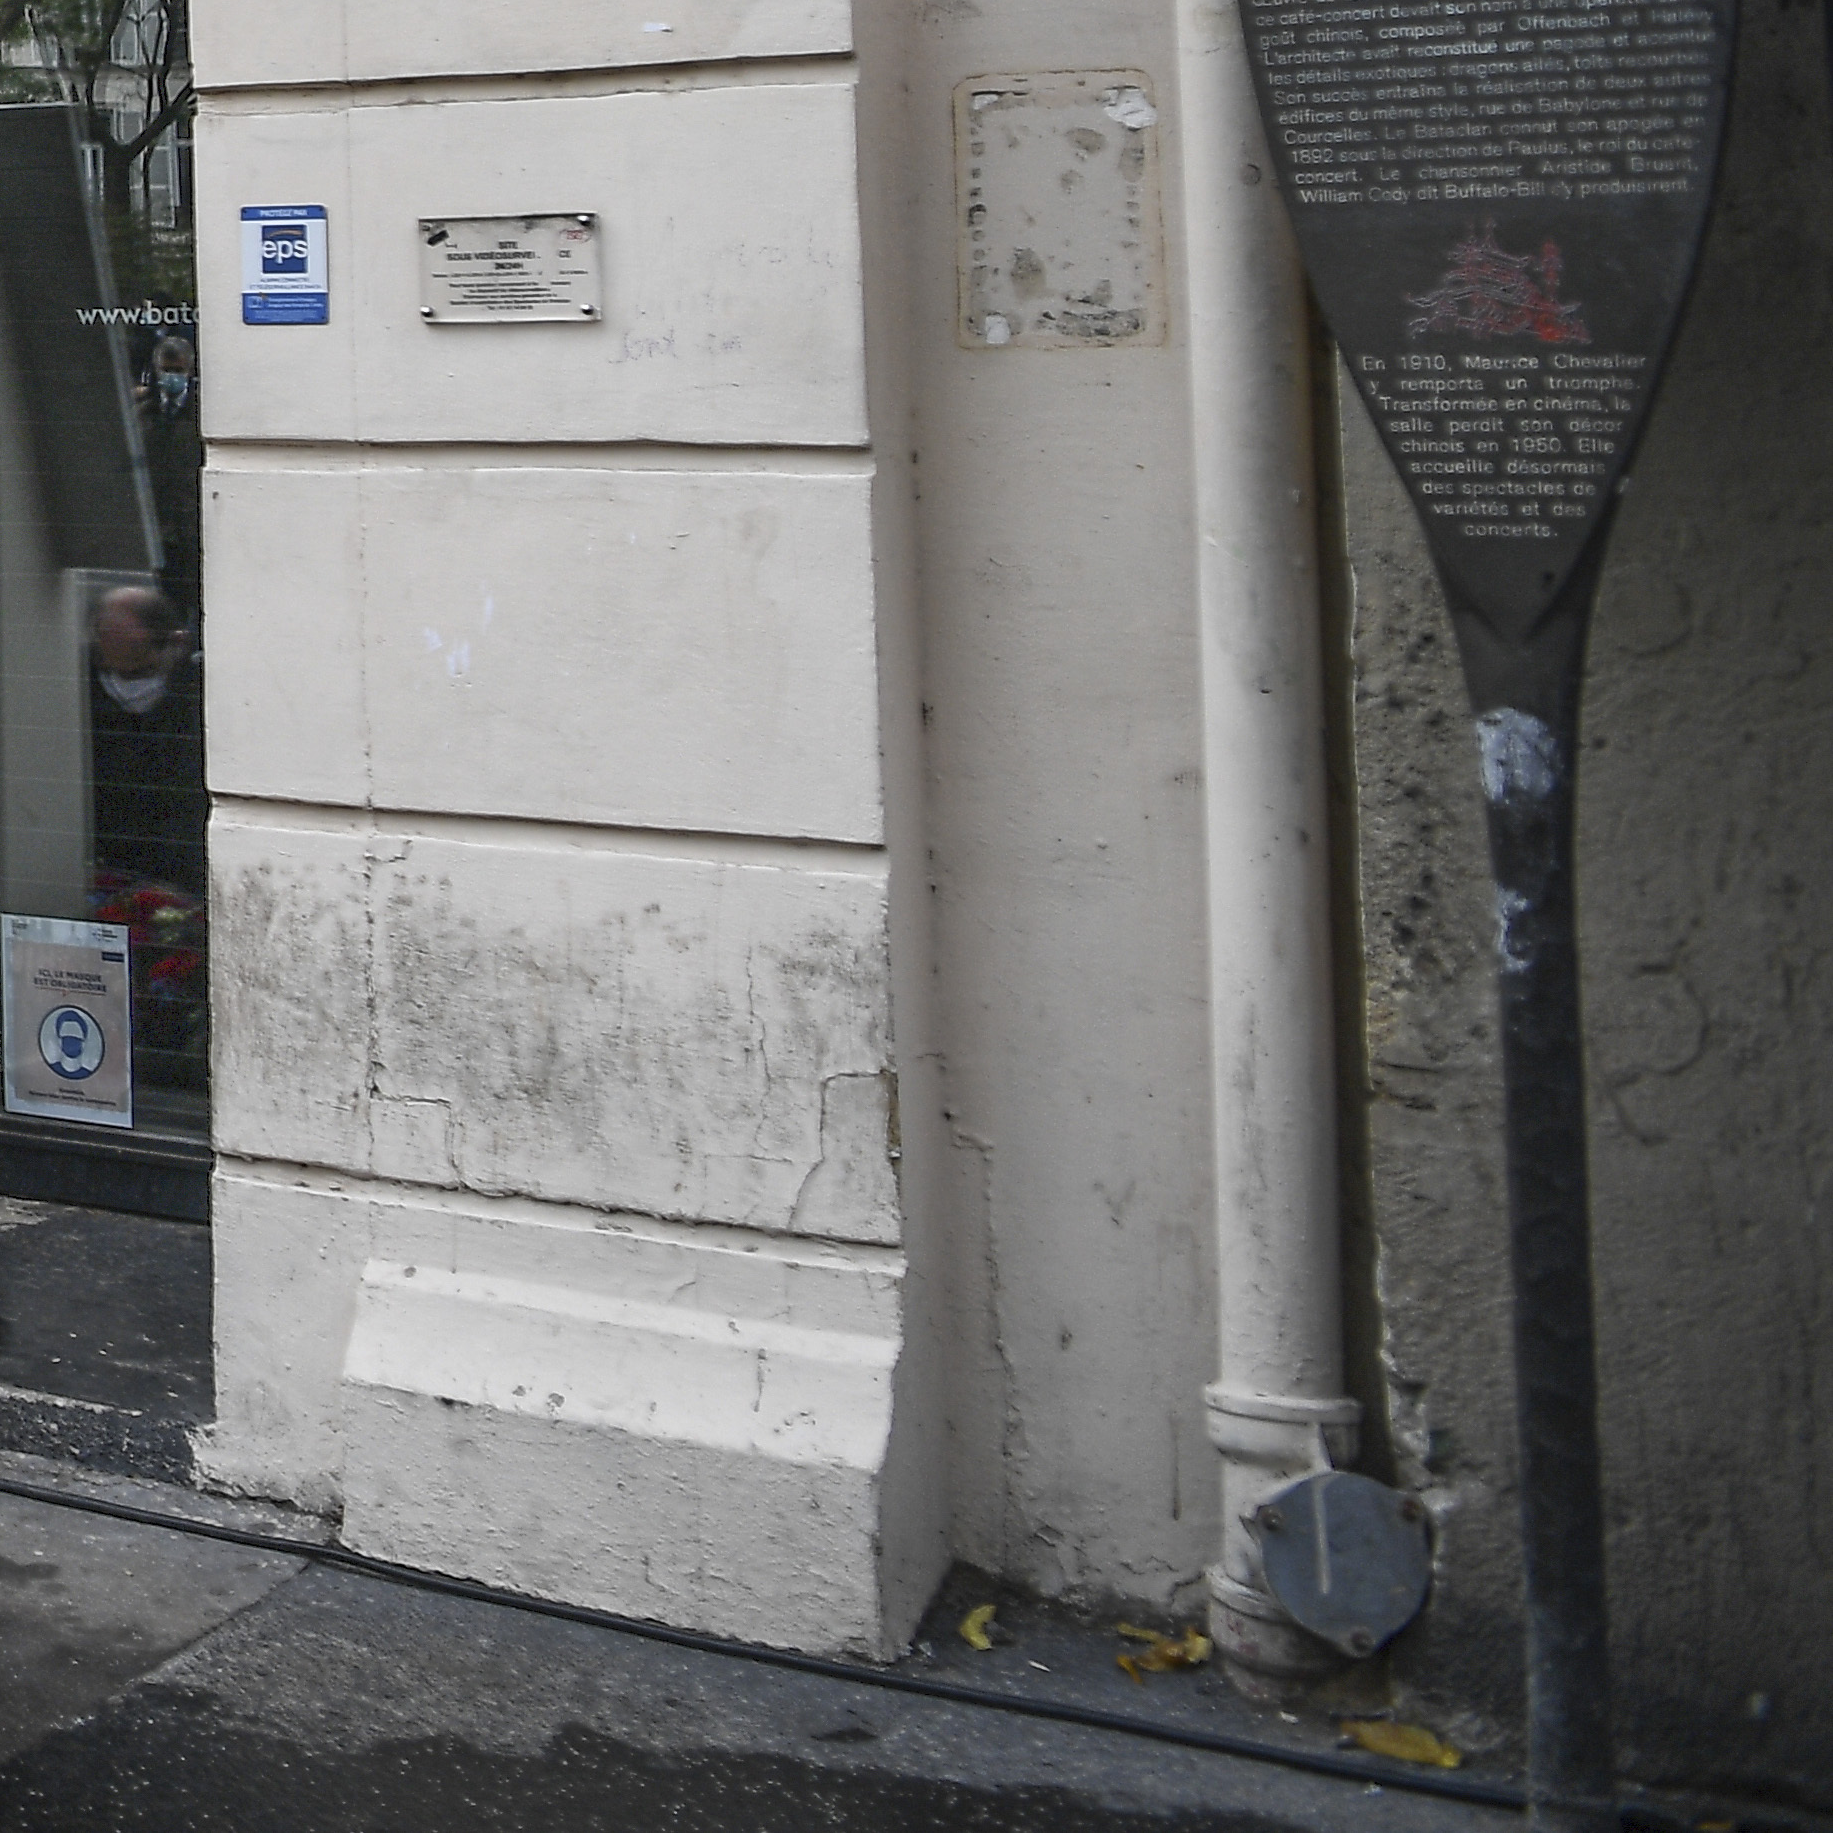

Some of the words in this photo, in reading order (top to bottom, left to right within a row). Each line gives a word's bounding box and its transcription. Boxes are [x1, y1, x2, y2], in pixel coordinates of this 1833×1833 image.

[1277, 4, 1386, 25] café-concert
[1445, 1, 1476, 15] son
[1476, 19, 1505, 36] par
[1517, 11, 1610, 31] Offenbach
[1347, 107, 1369, 121] du
[1290, 148, 1335, 163] 1892
[1299, 187, 1363, 203] William
[1367, 186, 1412, 205] Cody
[1416, 186, 1439, 200] dit
[263, 240, 308, 264] eps
[1362, 356, 1385, 371] En
[1399, 354, 1452, 373] 1910,
[1553, 352, 1645, 368] Chevalier
[1369, 380, 1379, 395] y
[1400, 378, 1484, 394] remporta
[1505, 378, 1527, 390] un
[1379, 395, 1498, 412] Transformée
[1504, 399, 1527, 411] en
[1614, 395, 1631, 410] la
[1390, 418, 1433, 432] salle
[1449, 418, 1504, 435] perdit
[1520, 418, 1554, 431] son
[1476, 440, 1499, 452] en
[1578, 437, 1614, 453] Elle
[1410, 458, 1494, 474] accueille
[1506, 458, 1605, 474] désormais
[1422, 480, 1453, 494] des
[1573, 480, 1596, 495] de
[1432, 500, 1509, 517] variétés
[1521, 502, 1539, 516] et
[1552, 502, 1586, 517] des
[1464, 522, 1558, 537] concerts.
